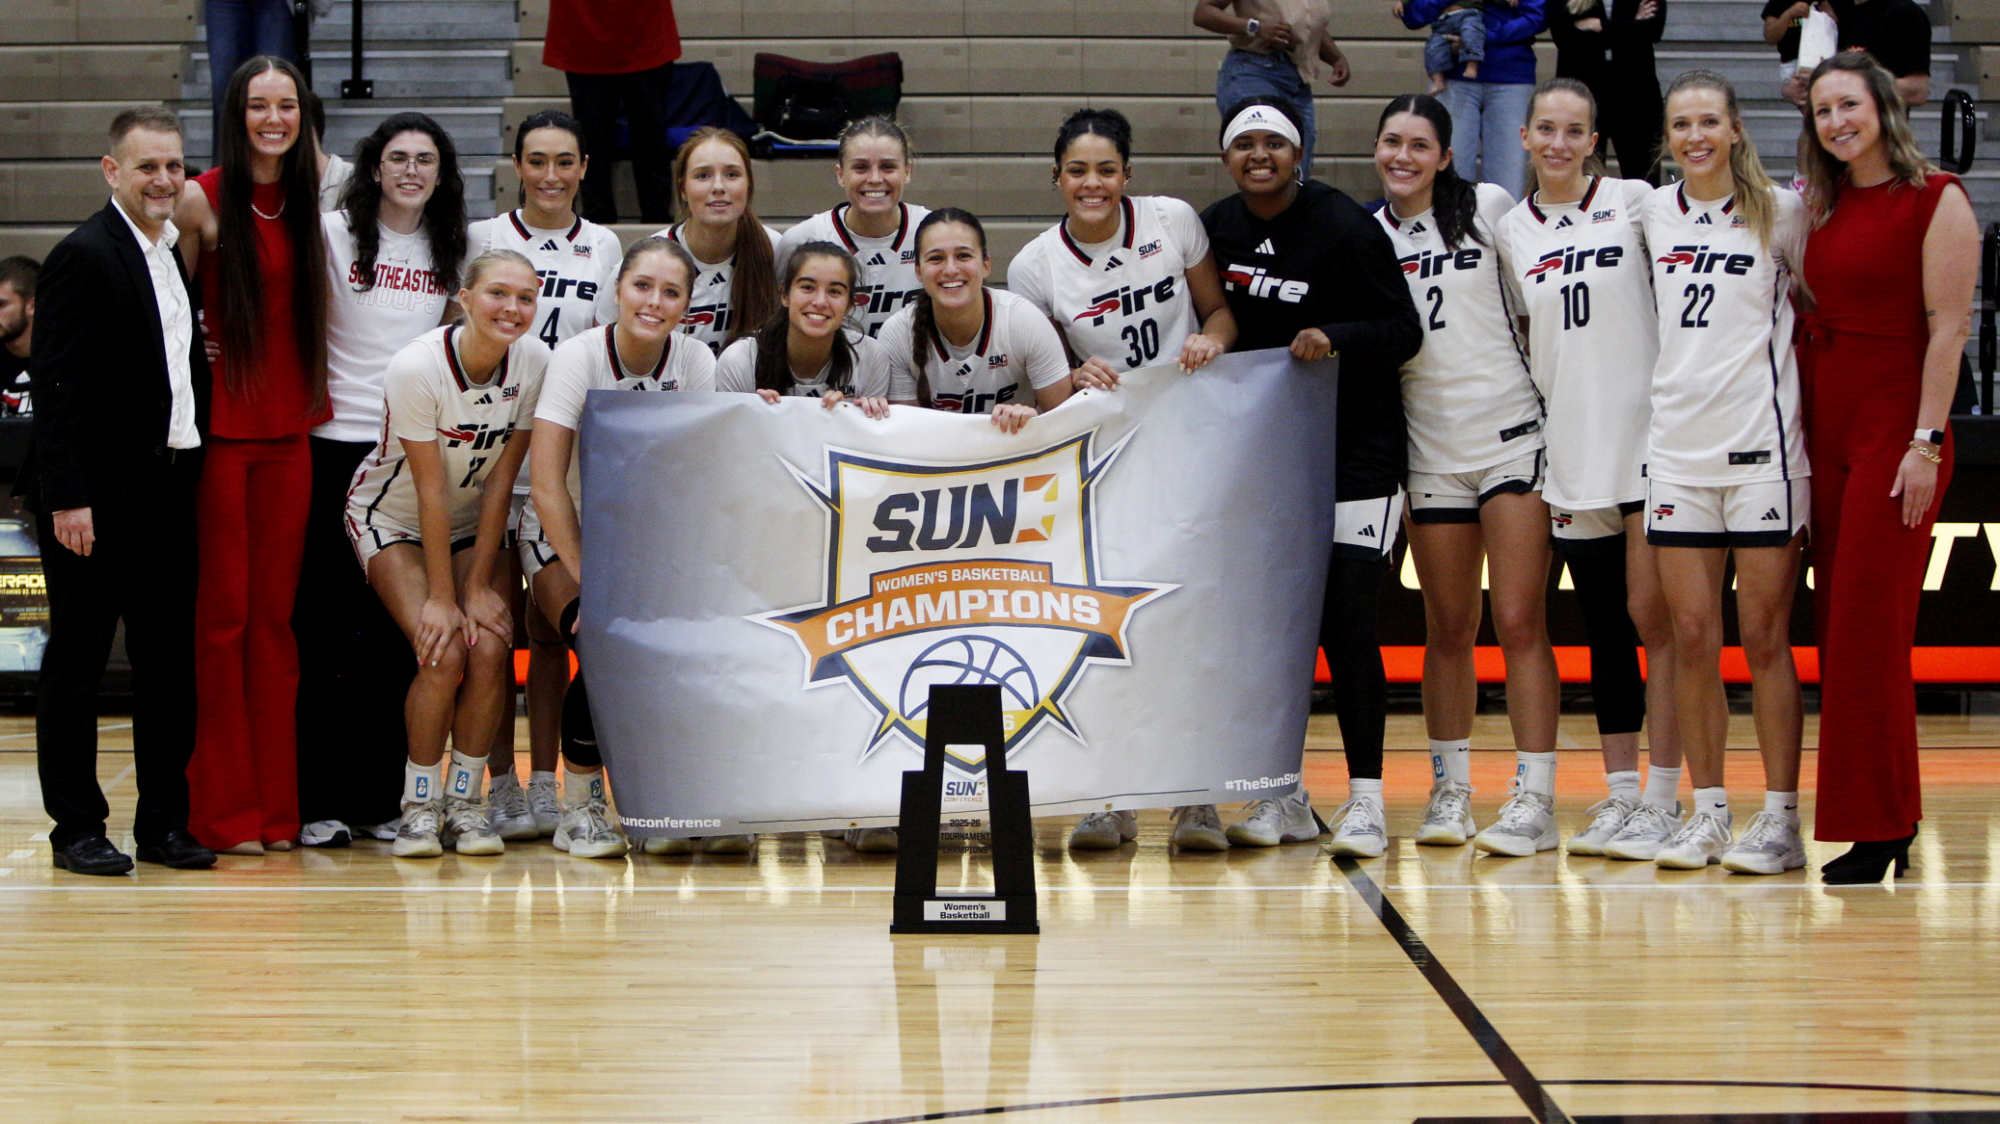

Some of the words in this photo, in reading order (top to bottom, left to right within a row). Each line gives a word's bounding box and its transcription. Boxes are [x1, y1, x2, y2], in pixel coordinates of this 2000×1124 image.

[1524, 245, 1624, 284] Fire
[1656, 245, 1756, 276] Fire
[1072, 275, 1176, 328] Fire
[1220, 263, 1310, 304] Fire
[1426, 285, 1447, 332] 2
[1560, 281, 1591, 331] 10
[1680, 283, 1716, 328] 22
[539, 306, 561, 351] 4
[1121, 317, 1160, 369] 30
[876, 570, 948, 593] WOMEN'S
[951, 568, 1047, 583] BASKETBALL
[826, 589, 1101, 646] CHAMPIONS
[940, 832, 990, 841] TOURNAMENT
[949, 819, 981, 828] 2025-26
[942, 846, 988, 854] CHAMPIONS
[940, 911, 990, 919] Basketball
[944, 903, 986, 911] Women's
